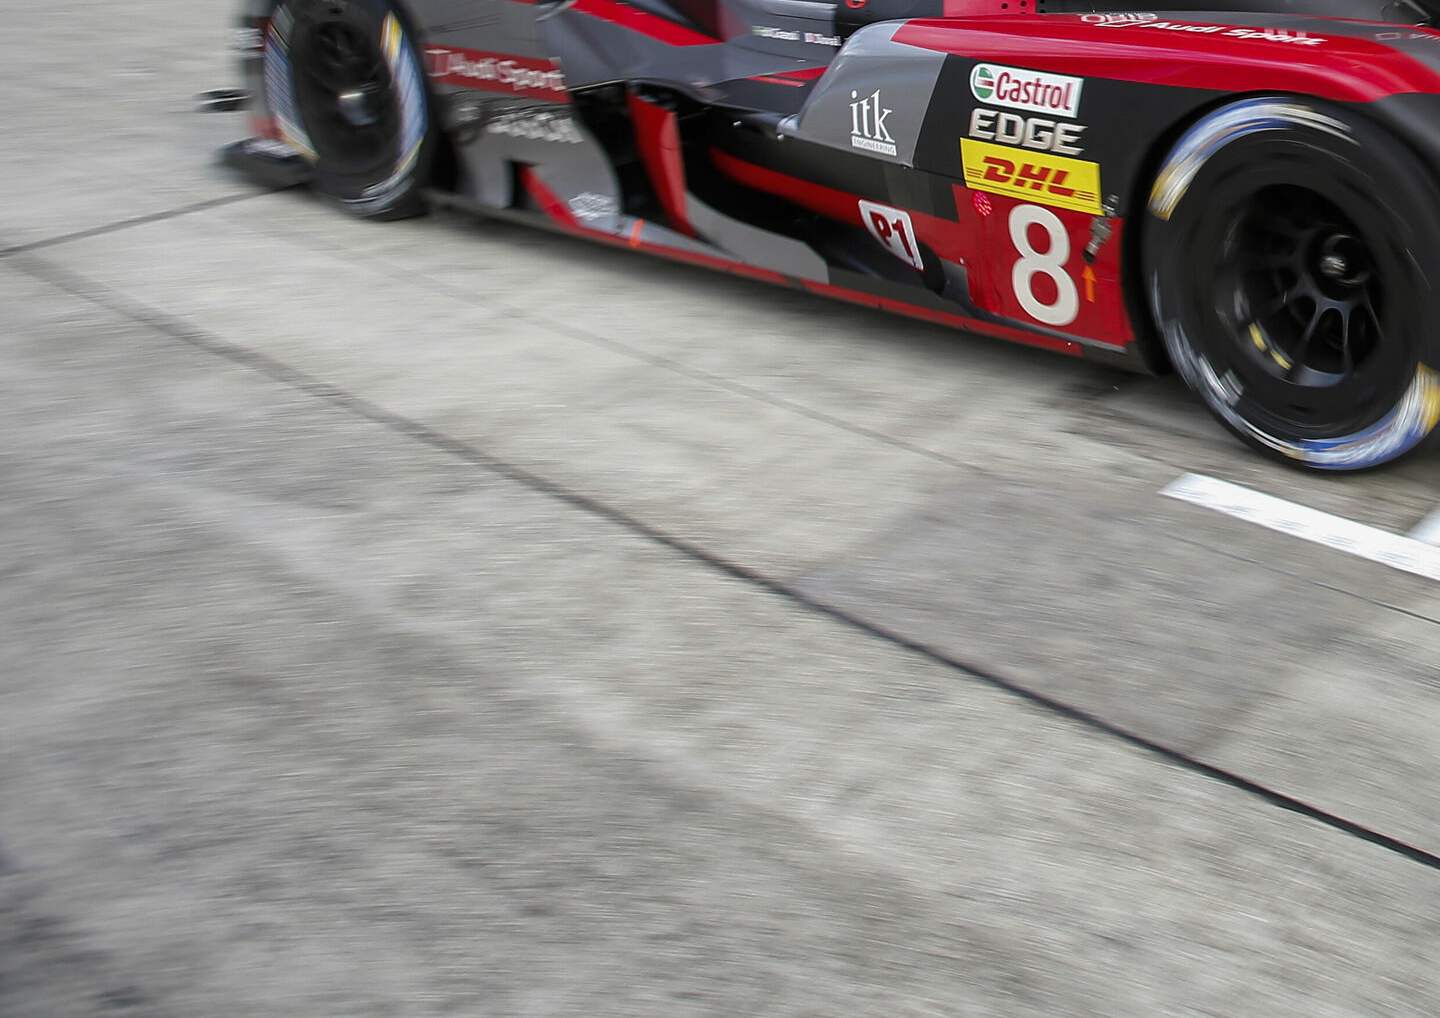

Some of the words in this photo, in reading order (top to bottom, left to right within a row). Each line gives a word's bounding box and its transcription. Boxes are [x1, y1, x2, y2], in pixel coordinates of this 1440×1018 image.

[1148, 21, 1219, 34] Audi
[1221, 28, 1328, 45] Sport
[850, 88, 896, 144] itk
[995, 70, 1074, 114] Castrol
[969, 108, 1088, 156] EDGE
[982, 156, 1076, 197] DHL
[870, 209, 914, 259] P1
[1008, 203, 1080, 327] 8
